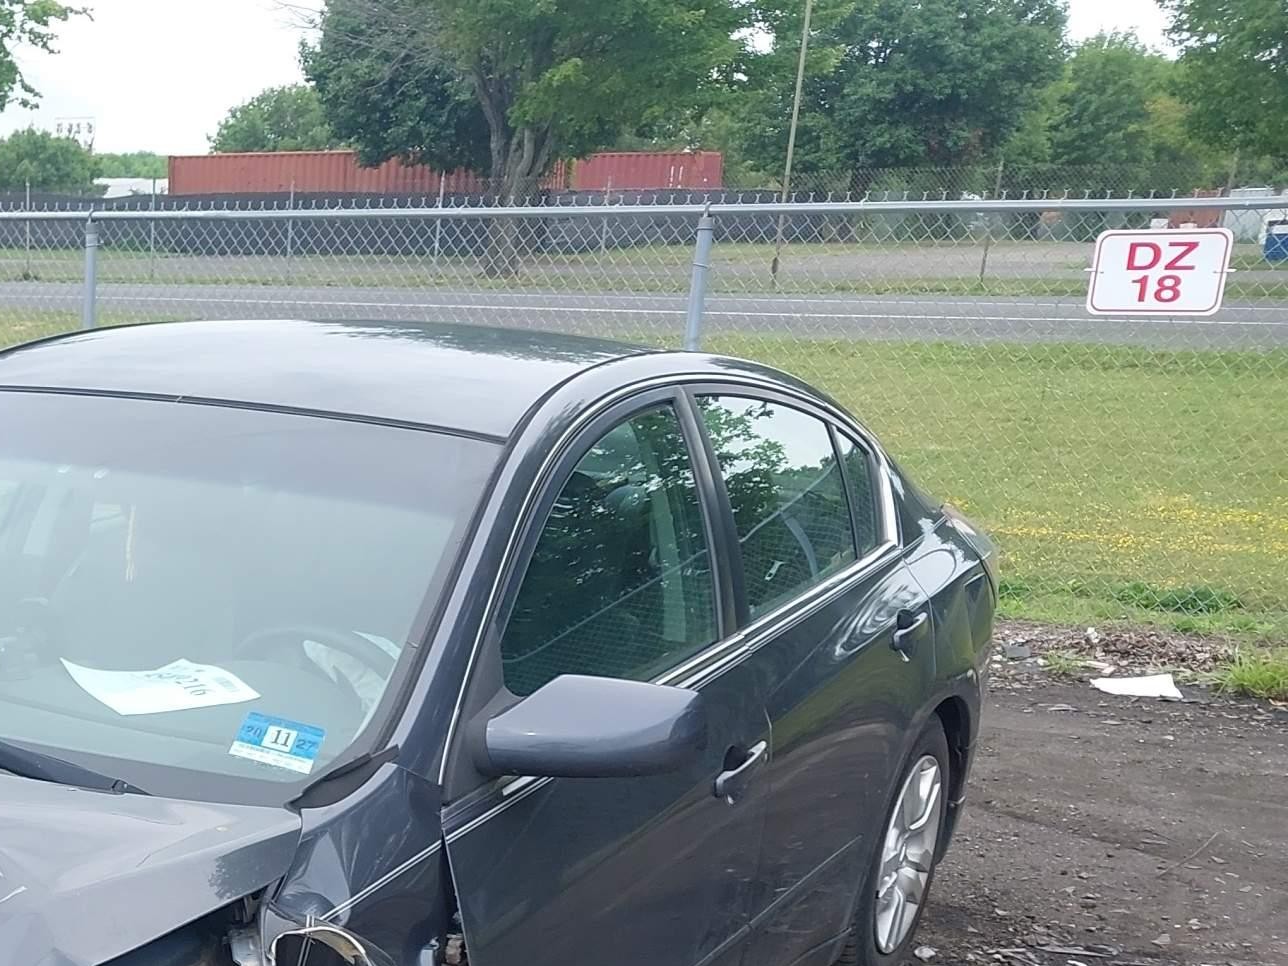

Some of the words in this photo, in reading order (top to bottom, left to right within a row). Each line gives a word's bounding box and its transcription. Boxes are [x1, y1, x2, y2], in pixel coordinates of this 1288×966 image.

[1126, 241, 1200, 271] DZ
[1131, 274, 1182, 303] 18
[271, 729, 292, 748] 11
[295, 739, 317, 752] 27
